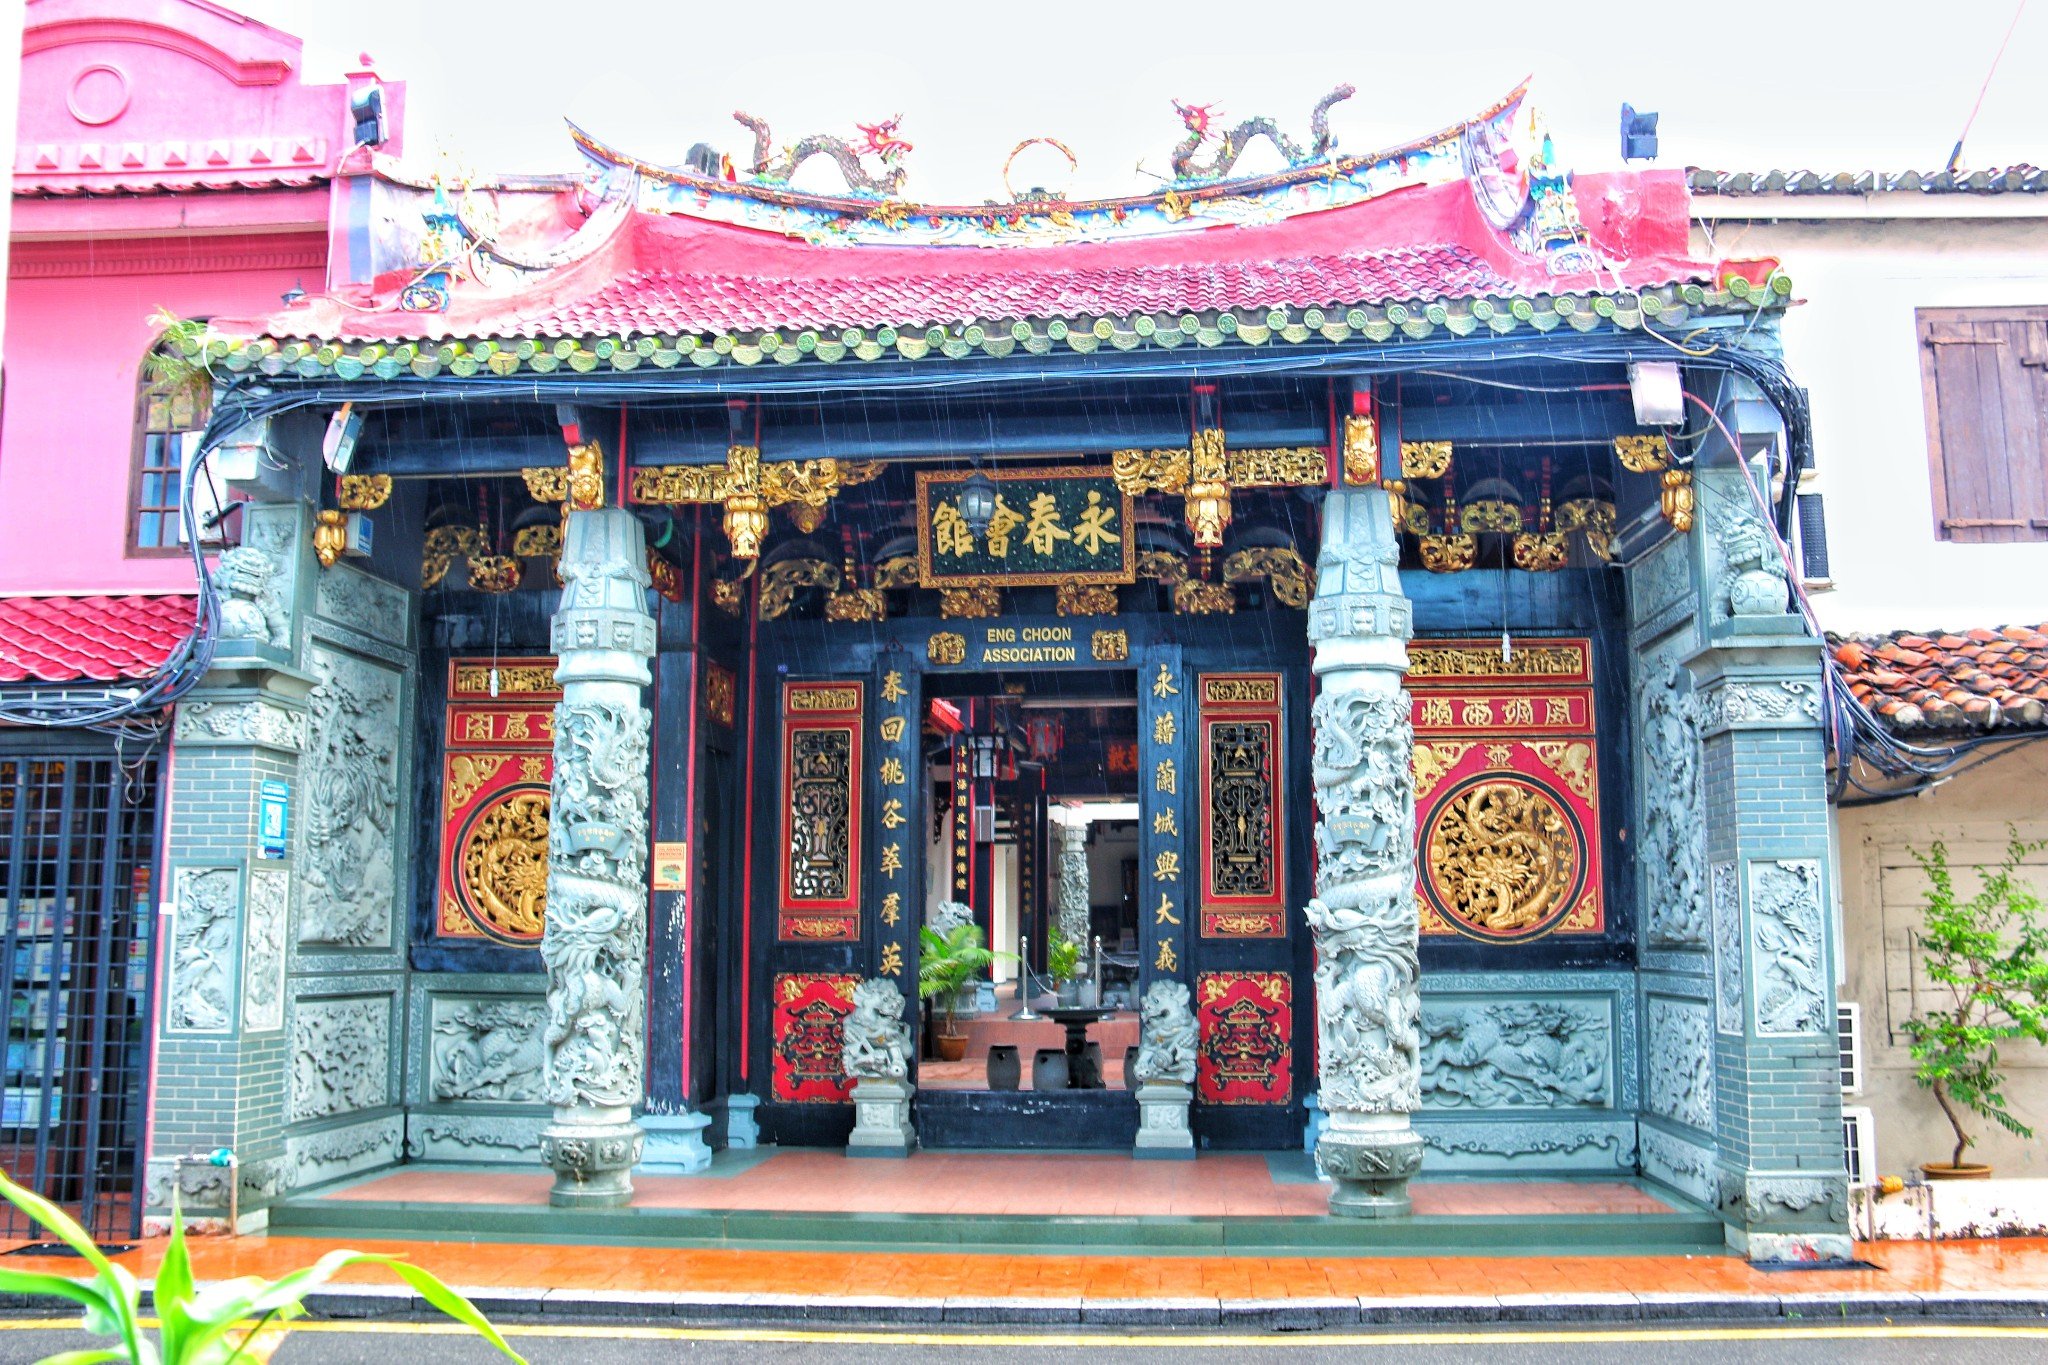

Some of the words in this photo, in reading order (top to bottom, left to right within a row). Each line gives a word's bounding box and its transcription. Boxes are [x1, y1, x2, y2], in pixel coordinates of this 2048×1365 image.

[987, 628, 1015, 643] ENG
[1022, 627, 1072, 641] CHOON
[983, 647, 1075, 663] ASSOCIATION
